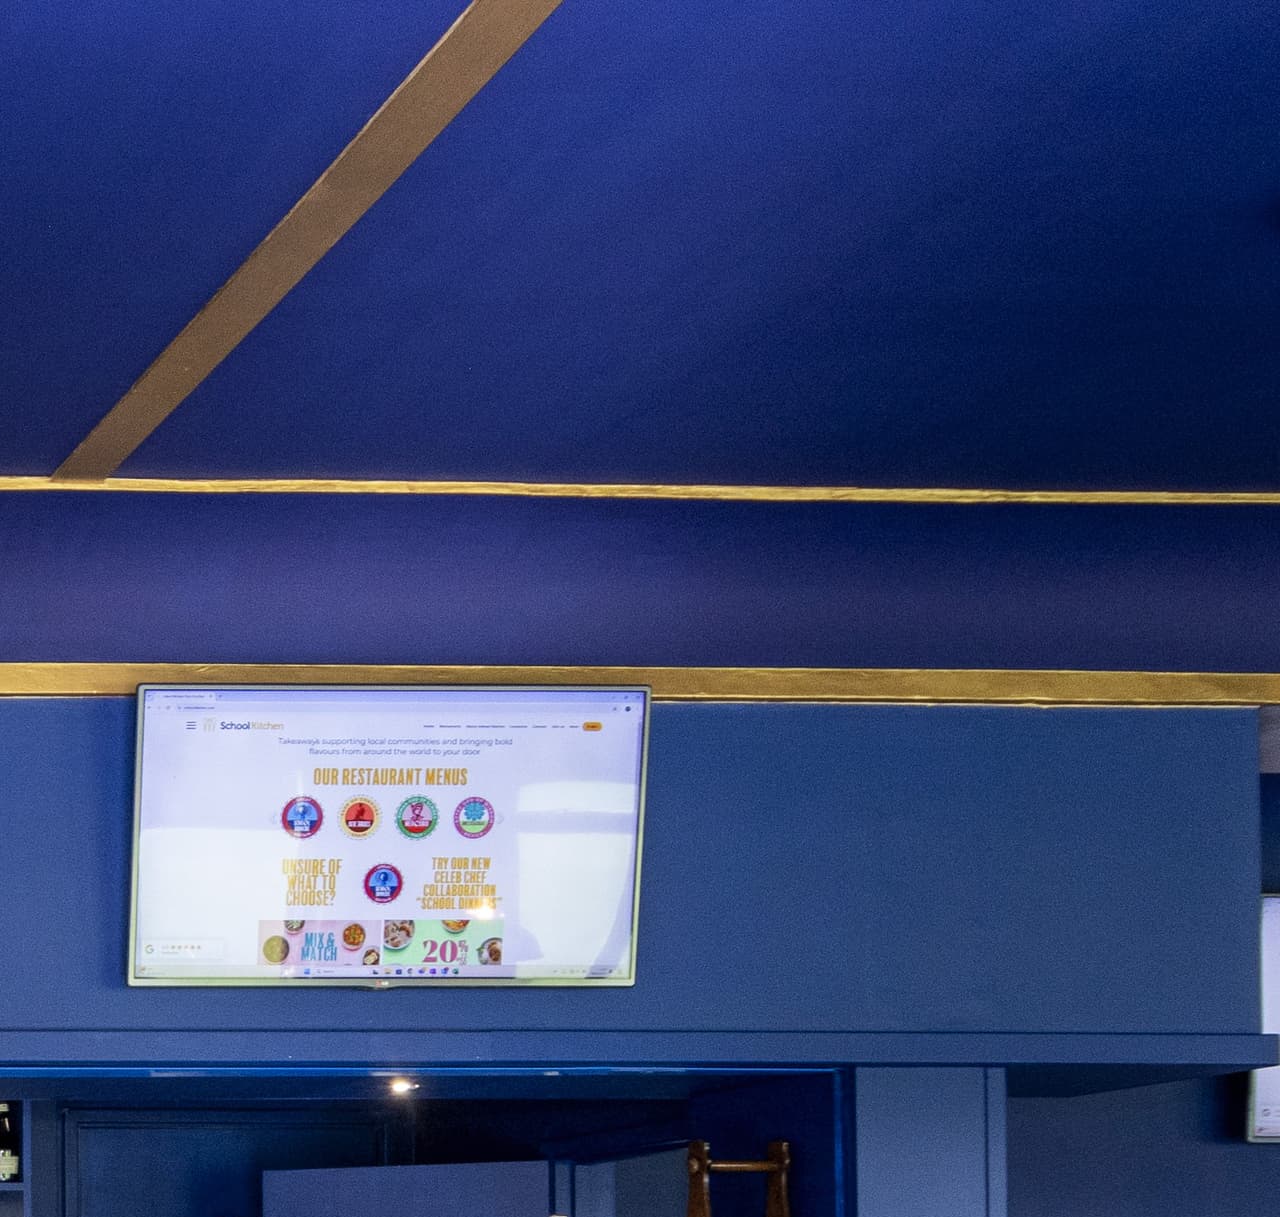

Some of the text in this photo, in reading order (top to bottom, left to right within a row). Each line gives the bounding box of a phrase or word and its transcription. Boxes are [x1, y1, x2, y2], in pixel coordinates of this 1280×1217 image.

[278, 737, 513, 748] Takeaways supporting local communities and bringing bold
[309, 748, 340, 756] flavours
[342, 748, 362, 756] from
[364, 748, 392, 756] around
[393, 748, 408, 756] the
[409, 748, 432, 756] world
[442, 749, 460, 757] your
[462, 748, 480, 756] door
[314, 768, 468, 786] OUR RESTAURANT MENUS
[282, 858, 343, 875] UNSURE OF
[432, 857, 491, 870] TRY OUR NEW
[288, 874, 336, 891] WHAT TO
[434, 871, 486, 884] CELEB CHEF
[424, 884, 496, 896] COLLABORATION
[286, 890, 336, 906] CHOOSE?
[304, 932, 335, 947] MIX &
[300, 946, 338, 962] MATCH
